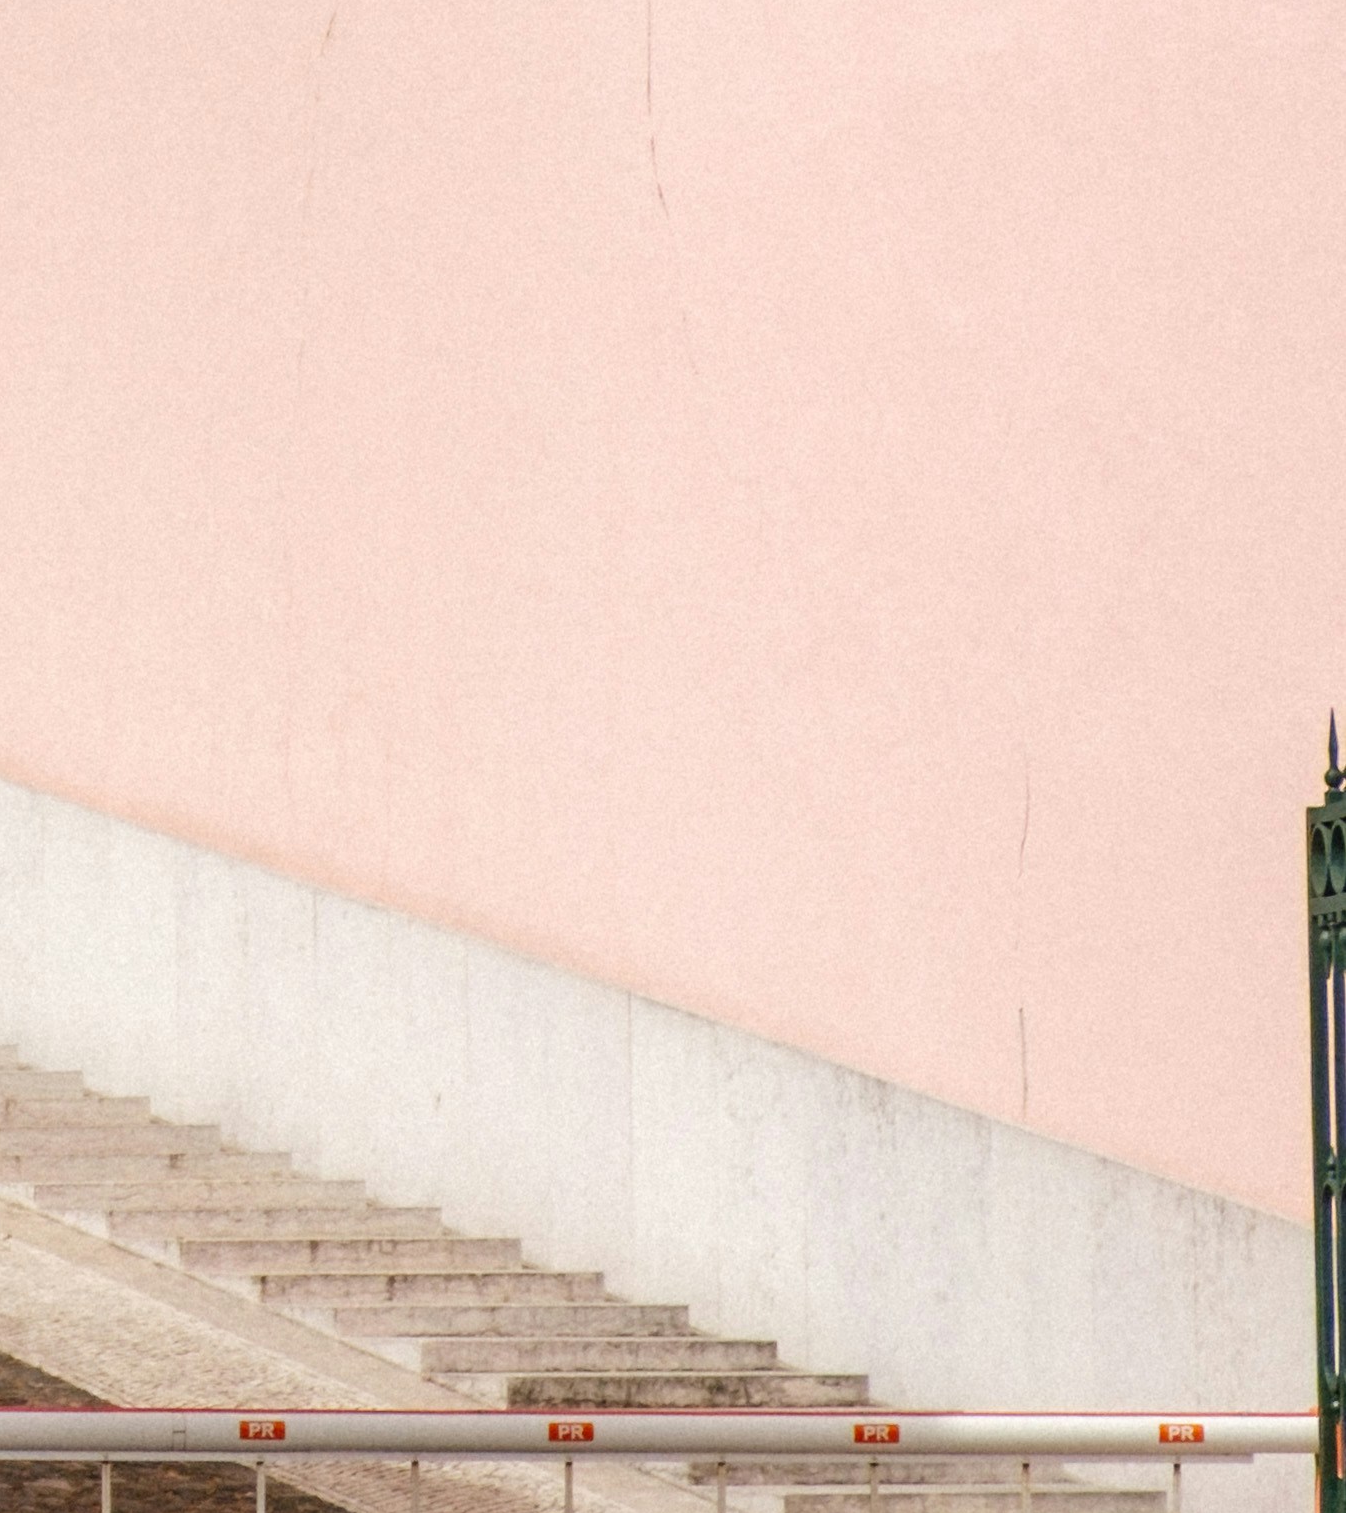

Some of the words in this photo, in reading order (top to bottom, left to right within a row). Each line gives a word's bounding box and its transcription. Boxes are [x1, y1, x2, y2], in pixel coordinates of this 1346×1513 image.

[249, 1422, 274, 1438] PR
[558, 1424, 585, 1439] PR
[863, 1425, 890, 1441] PR
[1168, 1425, 1195, 1441] PR
